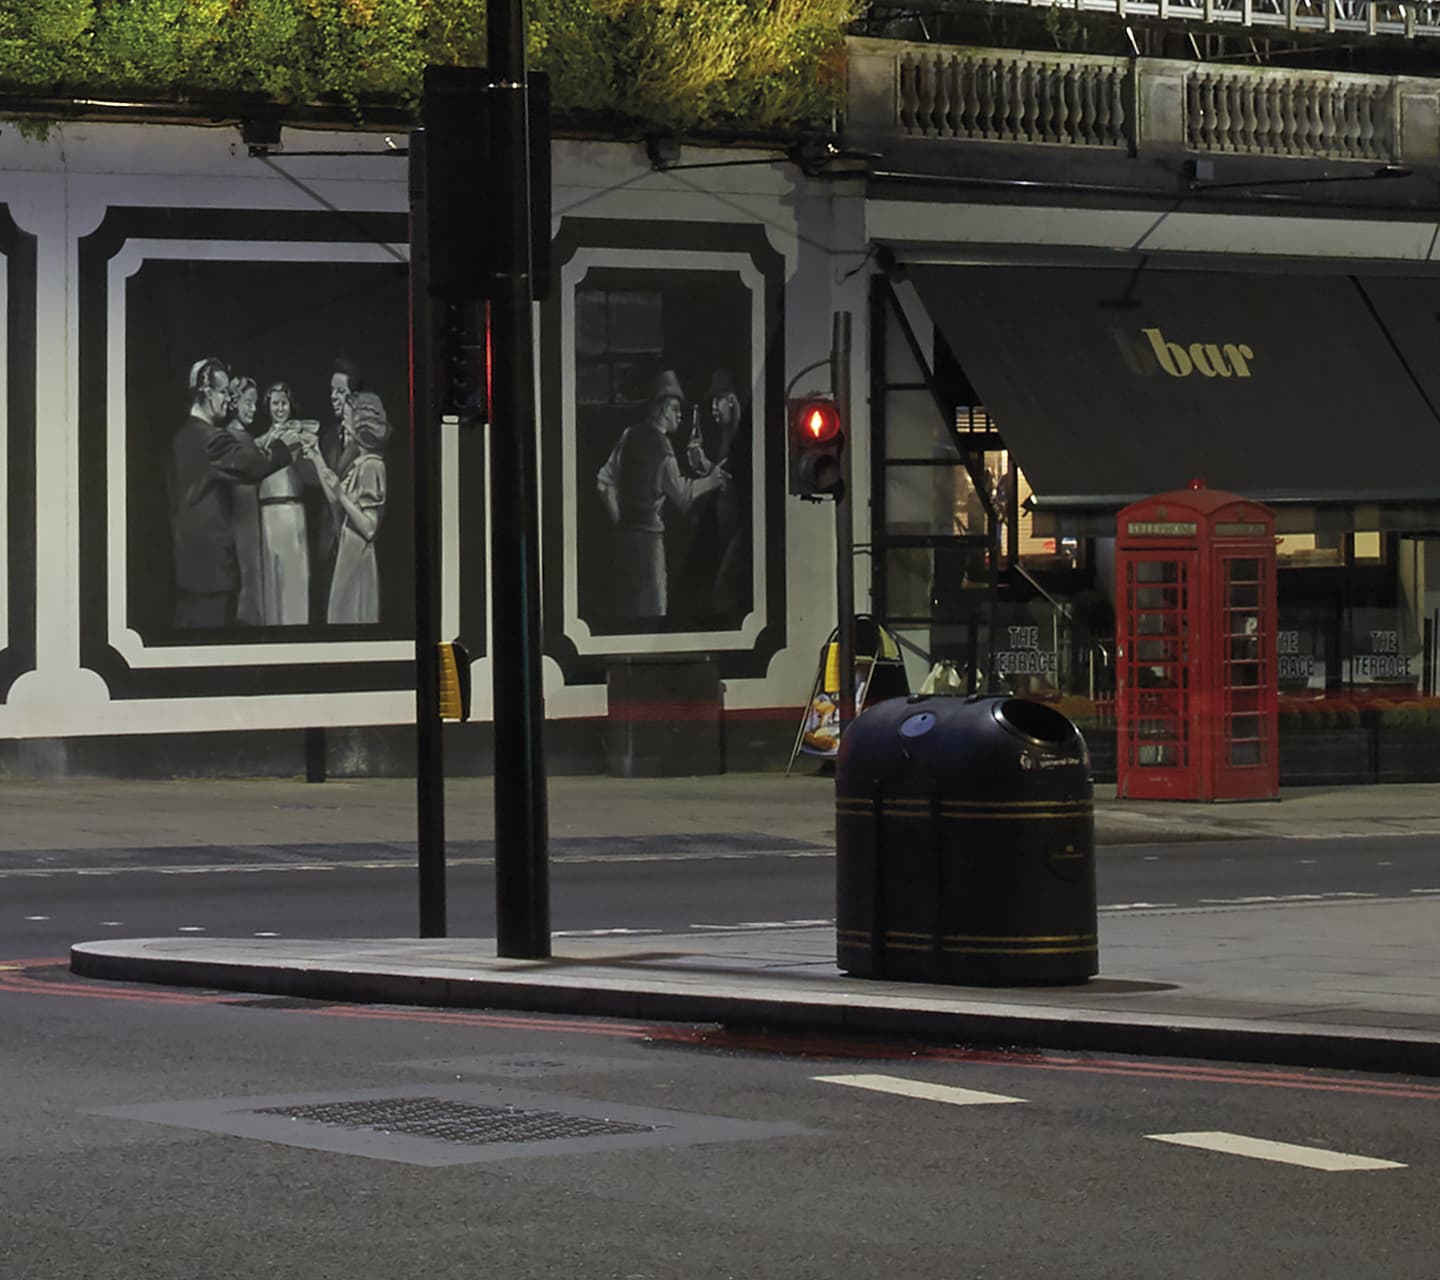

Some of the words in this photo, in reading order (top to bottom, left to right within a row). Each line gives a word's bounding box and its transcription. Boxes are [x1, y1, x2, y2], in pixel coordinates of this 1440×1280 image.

[1008, 626, 1039, 648] THE
[1371, 630, 1397, 653] THE
[1354, 656, 1412, 678] TERRACE
